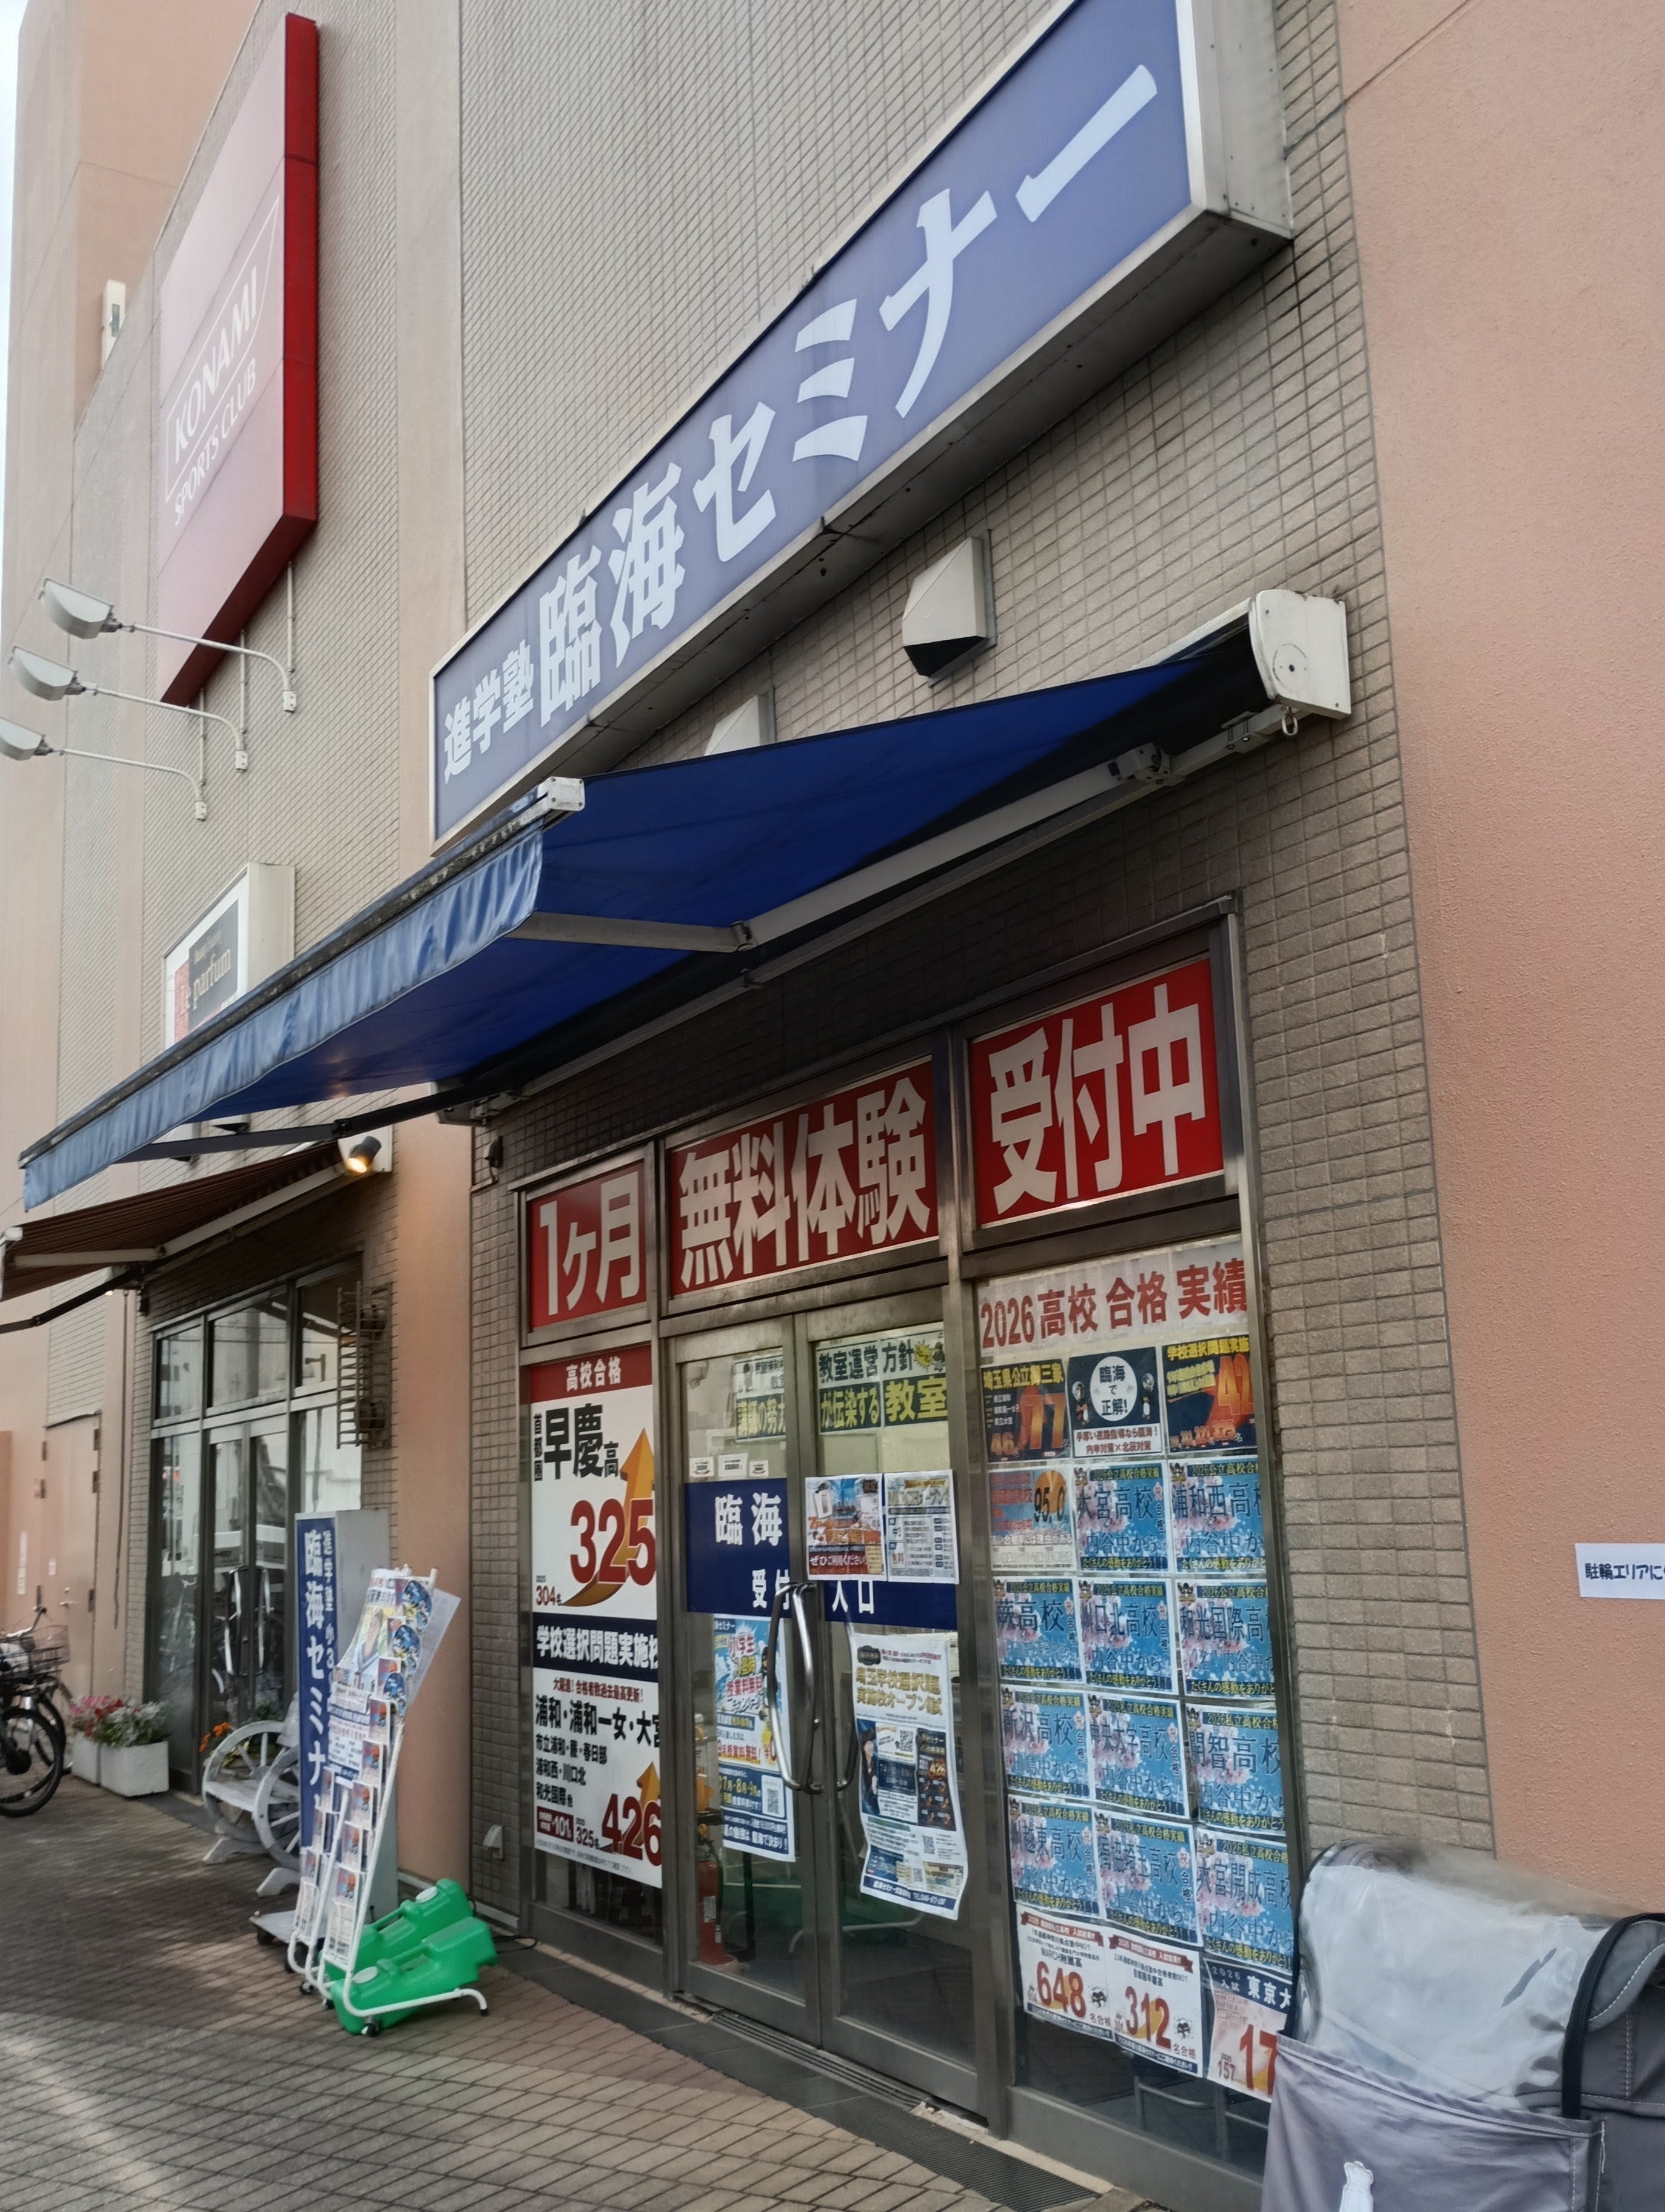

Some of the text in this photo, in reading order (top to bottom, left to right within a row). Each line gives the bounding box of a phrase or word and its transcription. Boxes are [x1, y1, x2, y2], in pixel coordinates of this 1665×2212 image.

[175, 266, 257, 464] KONAMI
[175, 358, 256, 525] SPORTS CLUB
[443, 64, 1157, 785] 進学塾 臨海セミナー
[678, 1078, 930, 1289] 無料体験
[990, 982, 1207, 1215] 受付中
[566, 1356, 621, 1392] 高校合格
[819, 1339, 914, 1383] 教室運営方針
[1099, 1365, 1125, 1383] 臨海
[1108, 1384, 1117, 1395] で
[715, 1492, 783, 1546] 臨海
[1077, 1486, 1154, 1521] 大宮高校
[570, 1498, 656, 1586] 325
[1202, 1586, 1268, 1598] 2026公立高校合
[1584, 1563, 1665, 1580] 駐輪エリアに
[1179, 1606, 1269, 1643] 和光国際高
[1190, 1731, 1281, 1775] 開智高校
[602, 1793, 662, 1866] 426
[1037, 1961, 1086, 2017] 648
[1247, 1976, 1292, 2009] 東京大
[1125, 1986, 1171, 2049] 312
